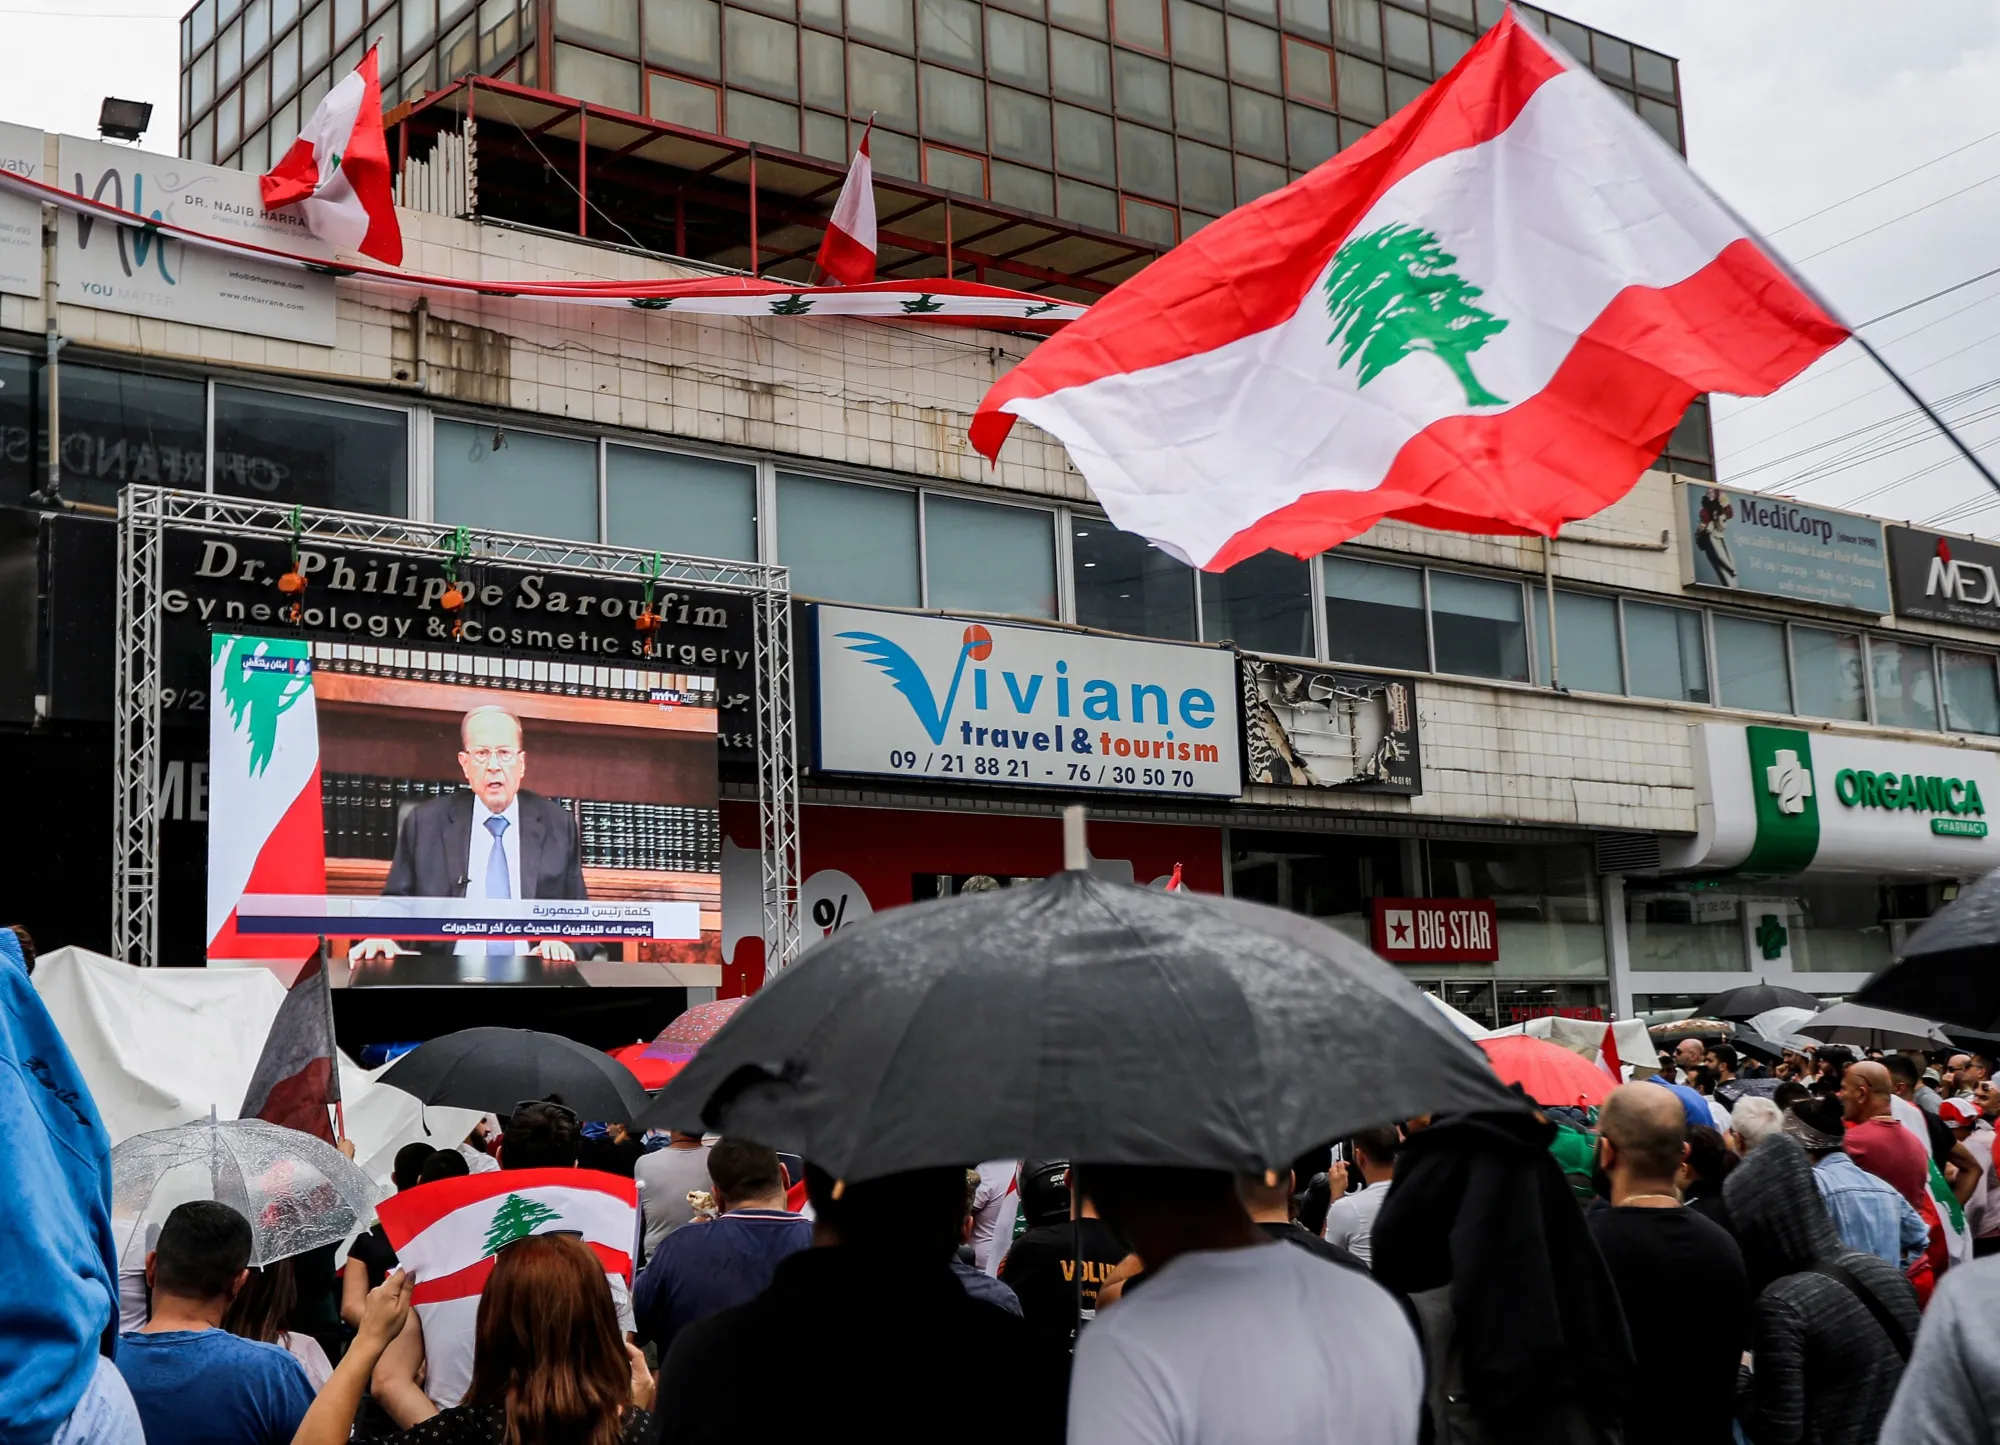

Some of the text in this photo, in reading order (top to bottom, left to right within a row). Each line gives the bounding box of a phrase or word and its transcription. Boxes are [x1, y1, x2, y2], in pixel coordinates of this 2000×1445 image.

[184, 195, 307, 227] DR. NAJIB HARRA
[81, 281, 175, 308] YOU MATTER
[219, 291, 305, 311] www.drharrane.com
[1739, 499, 1833, 545] MediCorp
[195, 540, 729, 629] Dr. Philippe Saroufim
[1926, 556, 2000, 607] MED
[161, 589, 750, 670] Gynecology & Cosmetic surgery
[650, 690, 680, 702] mtv
[833, 624, 1215, 746] Viviane
[659, 703, 673, 712] live
[960, 721, 1219, 763] travel & tourism
[890, 750, 916, 769] 09
[924, 753, 934, 772] /
[941, 754, 964, 773] 21
[974, 757, 1000, 776] 88
[1007, 759, 1029, 778] 21
[1067, 764, 1091, 782] 76
[1097, 765, 1106, 784] /
[1113, 766, 1136, 784] 30
[1143, 768, 1166, 786] 50
[1171, 769, 1194, 788] 70
[136, 760, 208, 822] ME
[1835, 768, 1985, 817] ORGANICA
[1937, 820, 1985, 834] PHARMACY
[441, 922, 488, 934] التطورات
[505, 922, 522, 934] عن
[524, 922, 561, 935] للحديث
[532, 904, 651, 918] كلمة رئيس الجمهورية
[1418, 910, 1492, 949] BIG STAR
